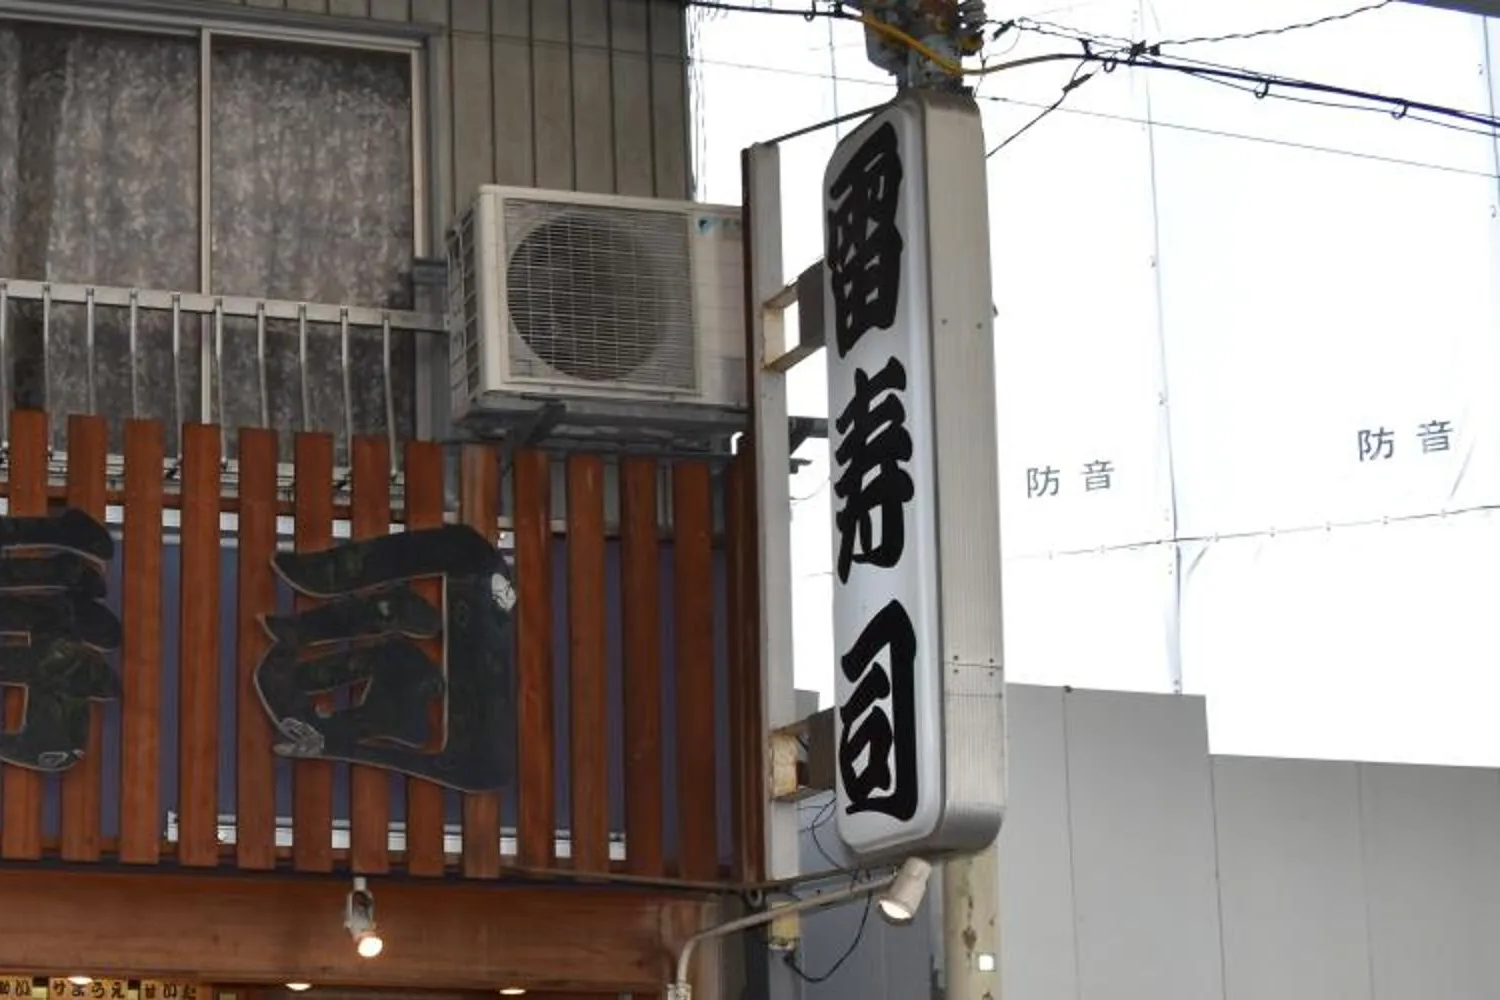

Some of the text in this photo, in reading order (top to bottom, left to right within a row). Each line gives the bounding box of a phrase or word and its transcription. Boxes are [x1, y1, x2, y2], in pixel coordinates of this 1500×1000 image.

[1357, 418, 1455, 463] 防音
[826, 120, 919, 822] 雷寿司
[1026, 459, 1115, 499] 防音
